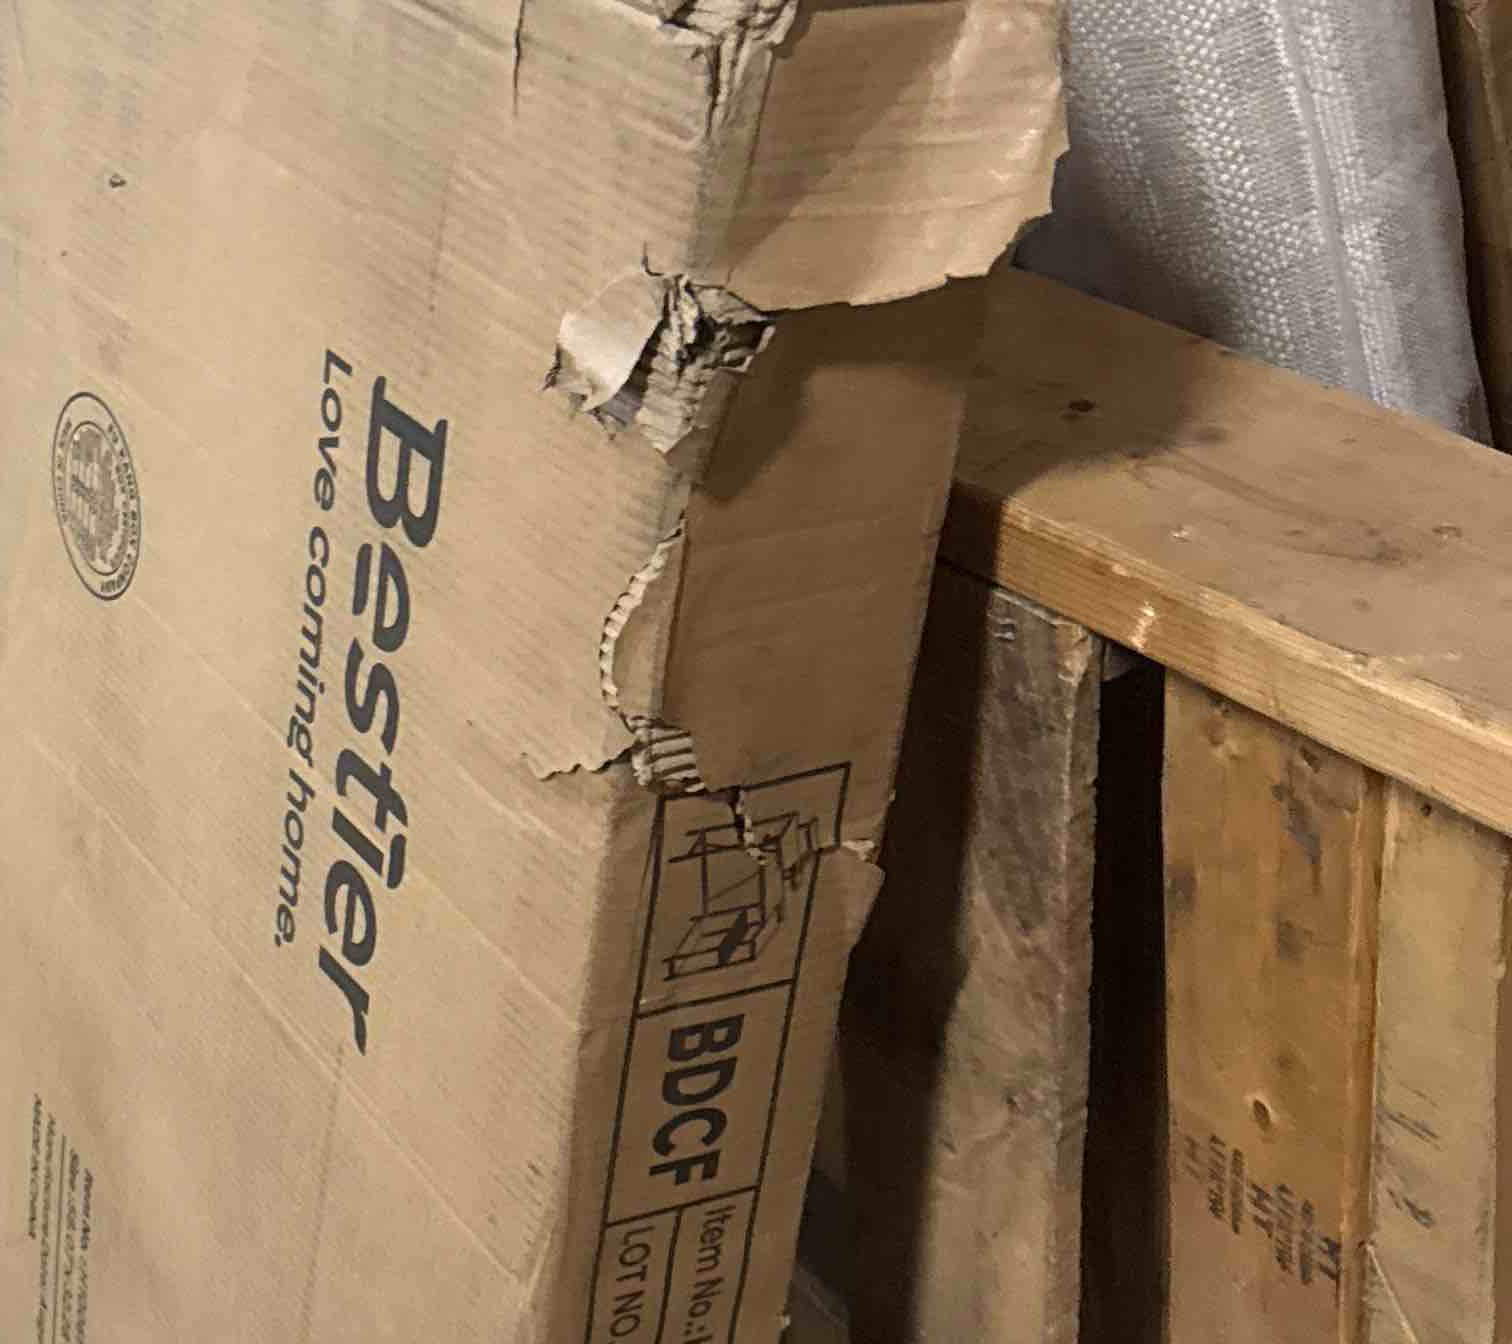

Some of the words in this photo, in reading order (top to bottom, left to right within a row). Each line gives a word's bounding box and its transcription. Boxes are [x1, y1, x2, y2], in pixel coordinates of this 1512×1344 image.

[311, 348, 352, 513] Love
[289, 527, 331, 764] coming
[274, 763, 317, 950] home.
[647, 1014, 745, 1191] BDCF
[616, 1225, 655, 1289] LOT
[693, 1204, 727, 1284] Item
